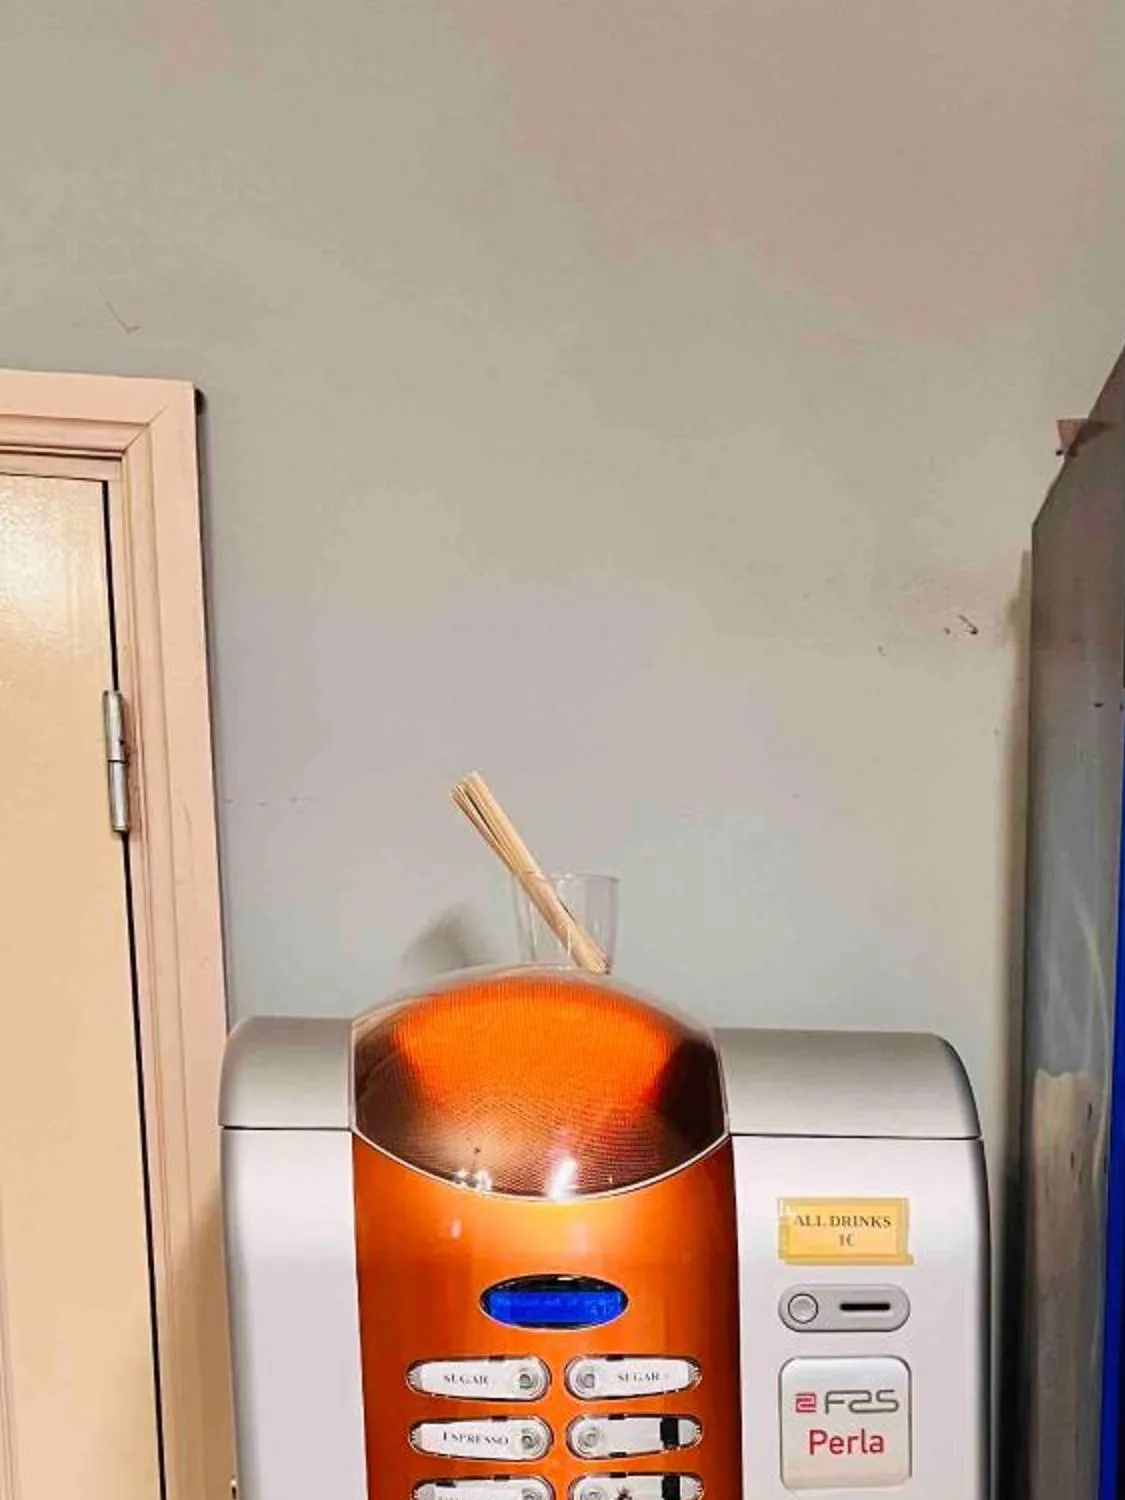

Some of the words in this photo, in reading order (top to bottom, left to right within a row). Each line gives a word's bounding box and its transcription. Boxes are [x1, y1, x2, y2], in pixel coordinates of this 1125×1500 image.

[794, 1215, 826, 1228] ALL
[829, 1214, 892, 1228] DRINKS
[808, 1429, 885, 1456] Perla
